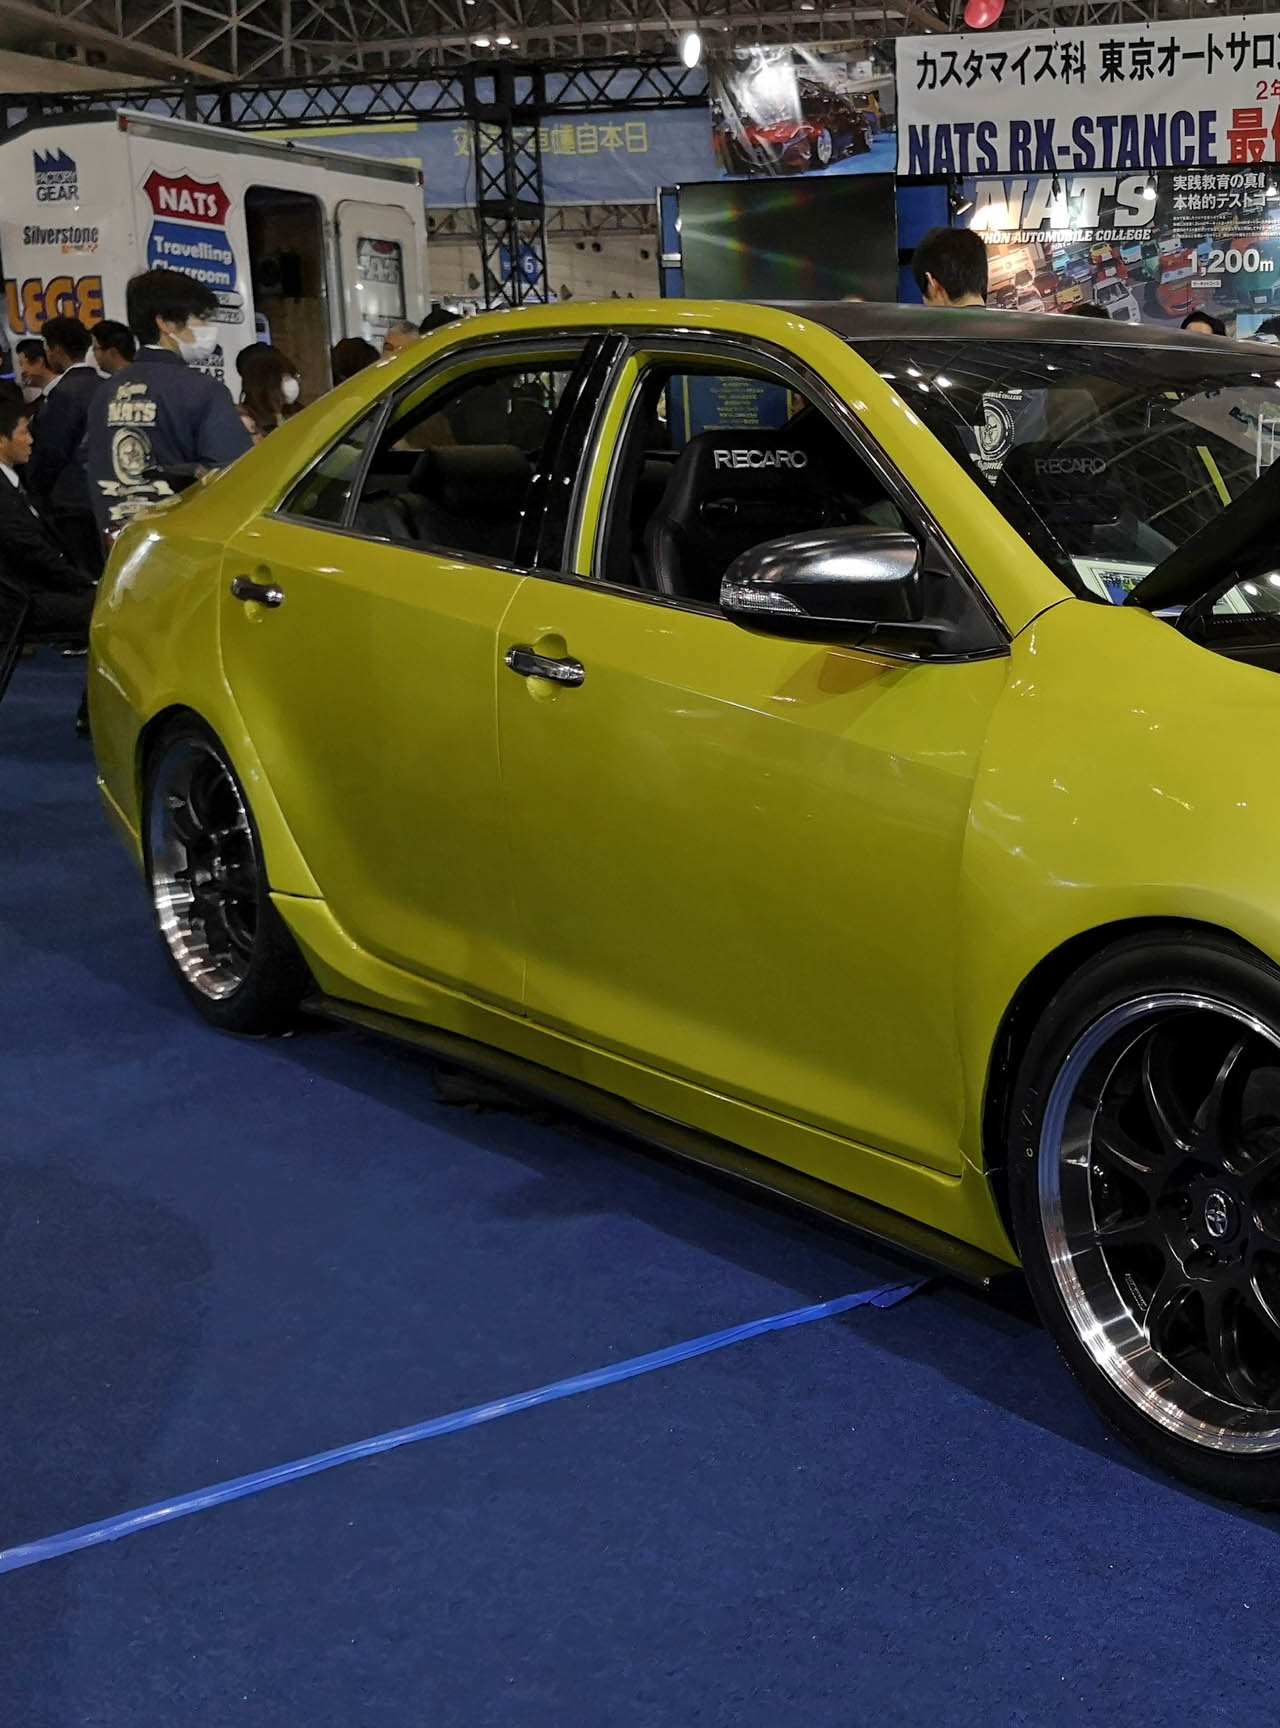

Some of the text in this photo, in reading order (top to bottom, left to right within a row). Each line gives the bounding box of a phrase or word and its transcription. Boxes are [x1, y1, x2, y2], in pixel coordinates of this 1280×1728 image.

[917, 40, 1086, 90] カスタマイズ科
[908, 121, 998, 175] NATS
[1010, 110, 1217, 171] RX-STANCE
[37, 186, 79, 201] GEAR
[158, 186, 218, 217] NATS
[970, 175, 1159, 231] NATS
[24, 226, 98, 245] Silverstone
[1013, 230, 1093, 244] AUTOMOBILE
[1096, 229, 1151, 242] COLLEGE
[153, 236, 233, 265] Travelling
[524, 256, 534, 274] 6
[108, 402, 158, 422] NATS
[714, 449, 809, 469] RECARO
[1035, 457, 1107, 475] RECARO
